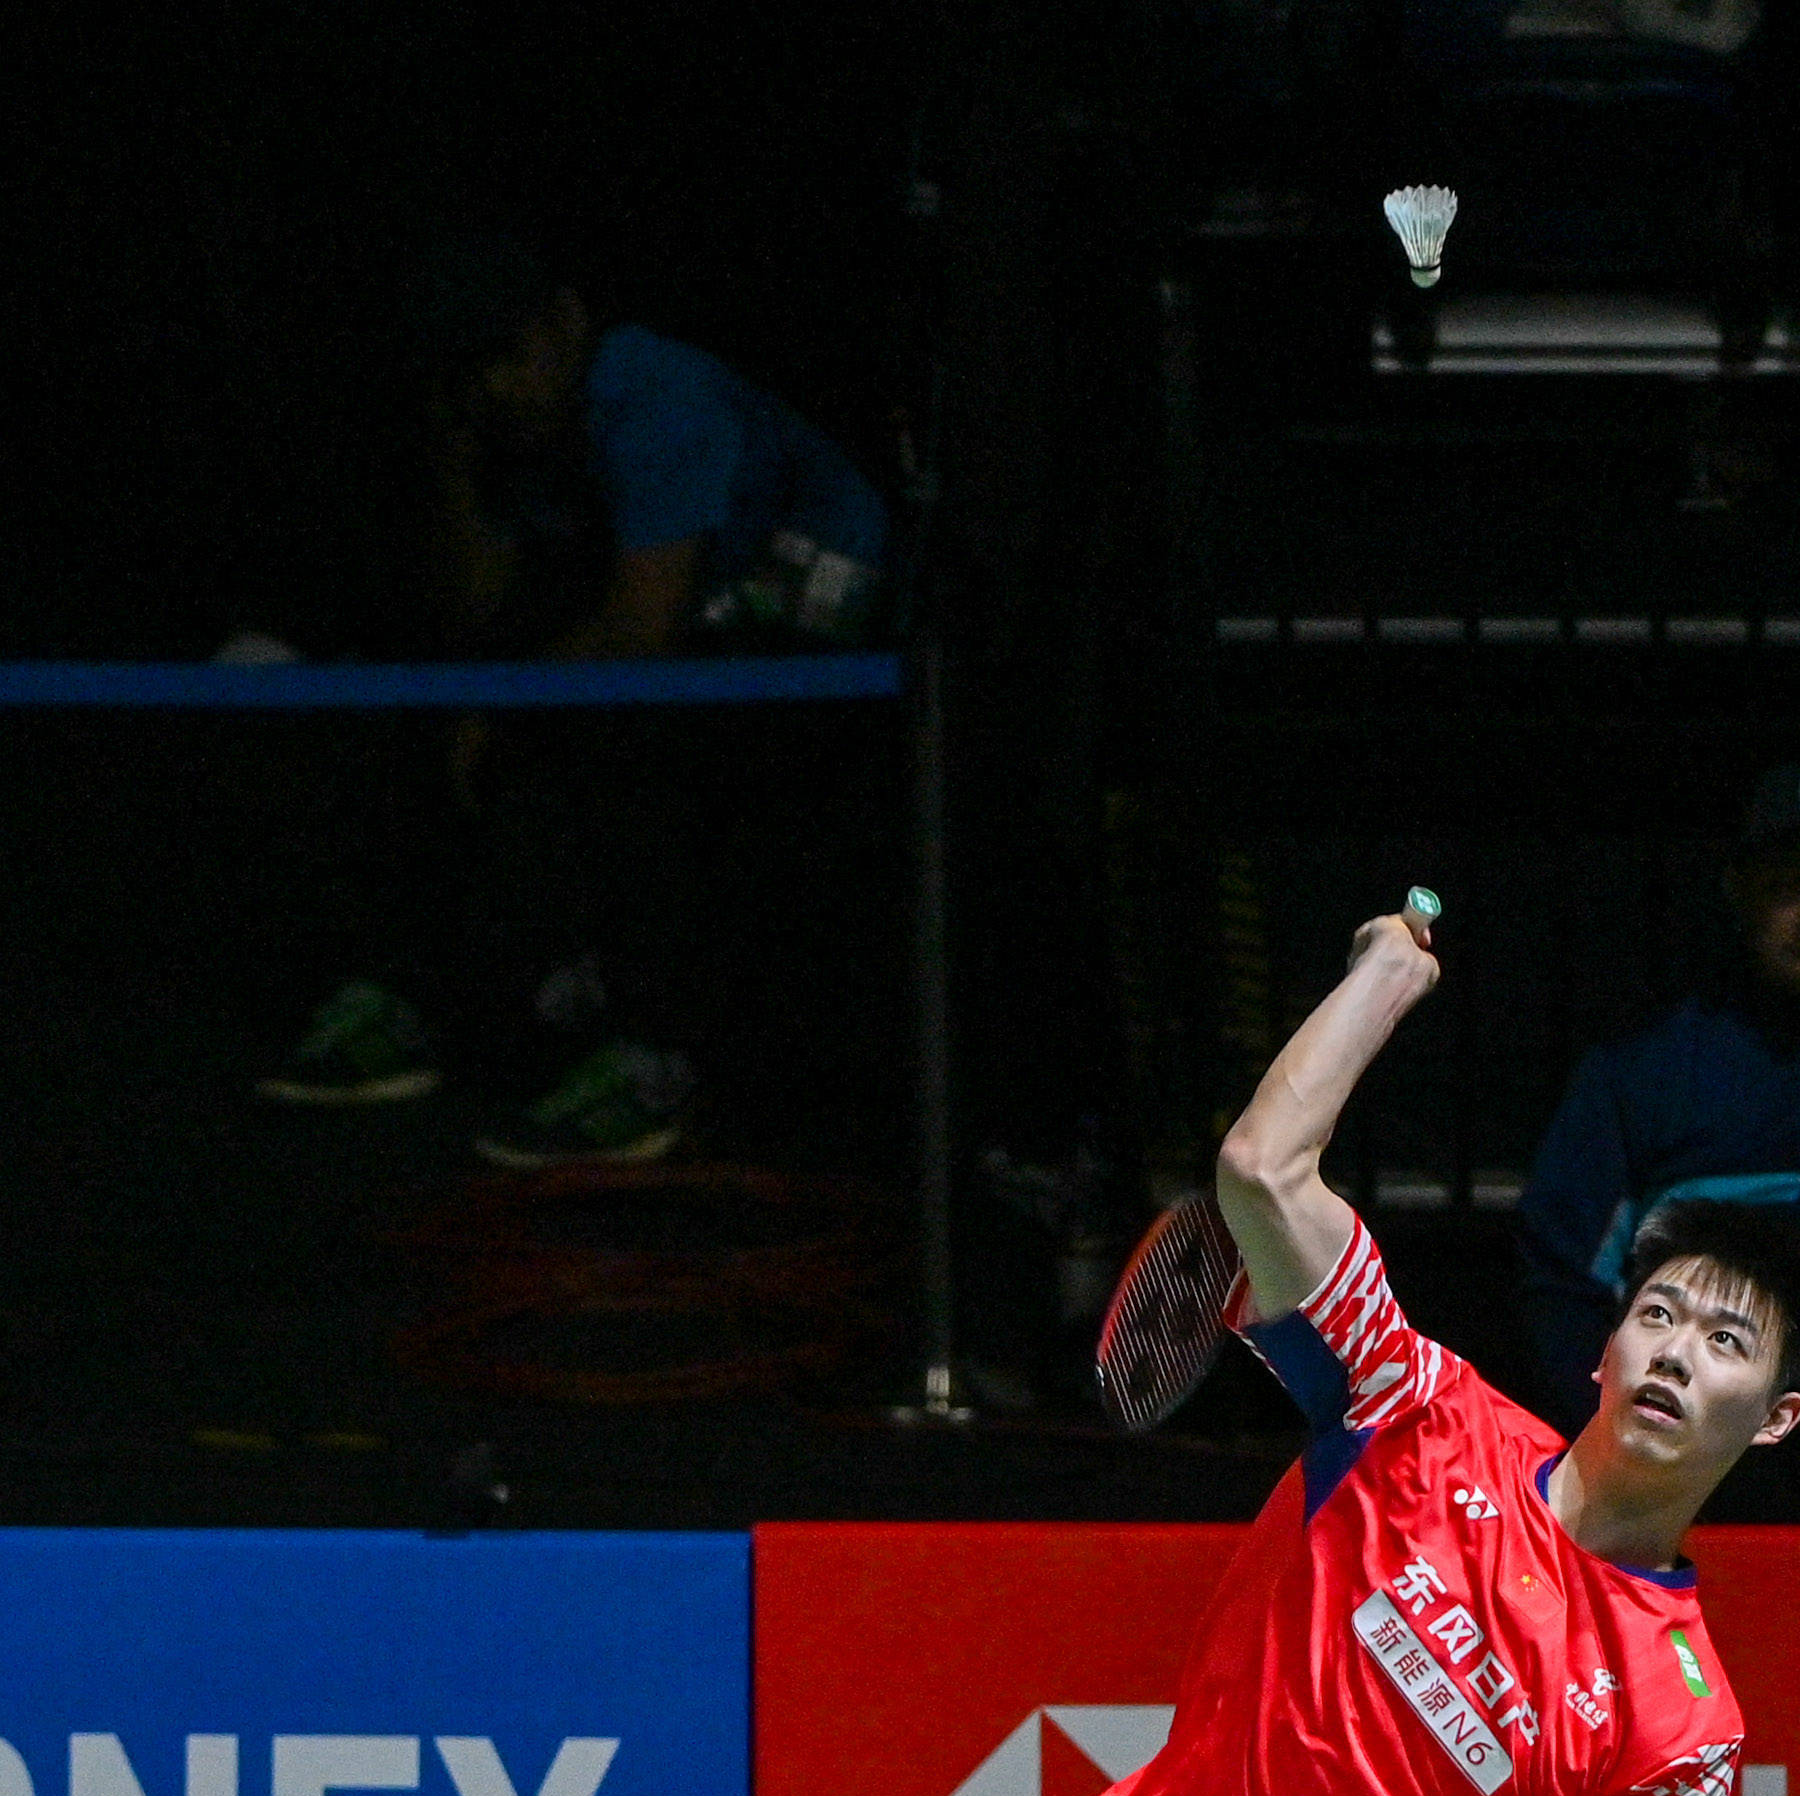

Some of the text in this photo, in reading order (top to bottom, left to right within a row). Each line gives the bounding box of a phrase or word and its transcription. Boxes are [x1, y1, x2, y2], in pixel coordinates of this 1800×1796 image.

[1370, 1616, 1494, 1766] 新能源N6
[1392, 1555, 1541, 1747] 东风日产
